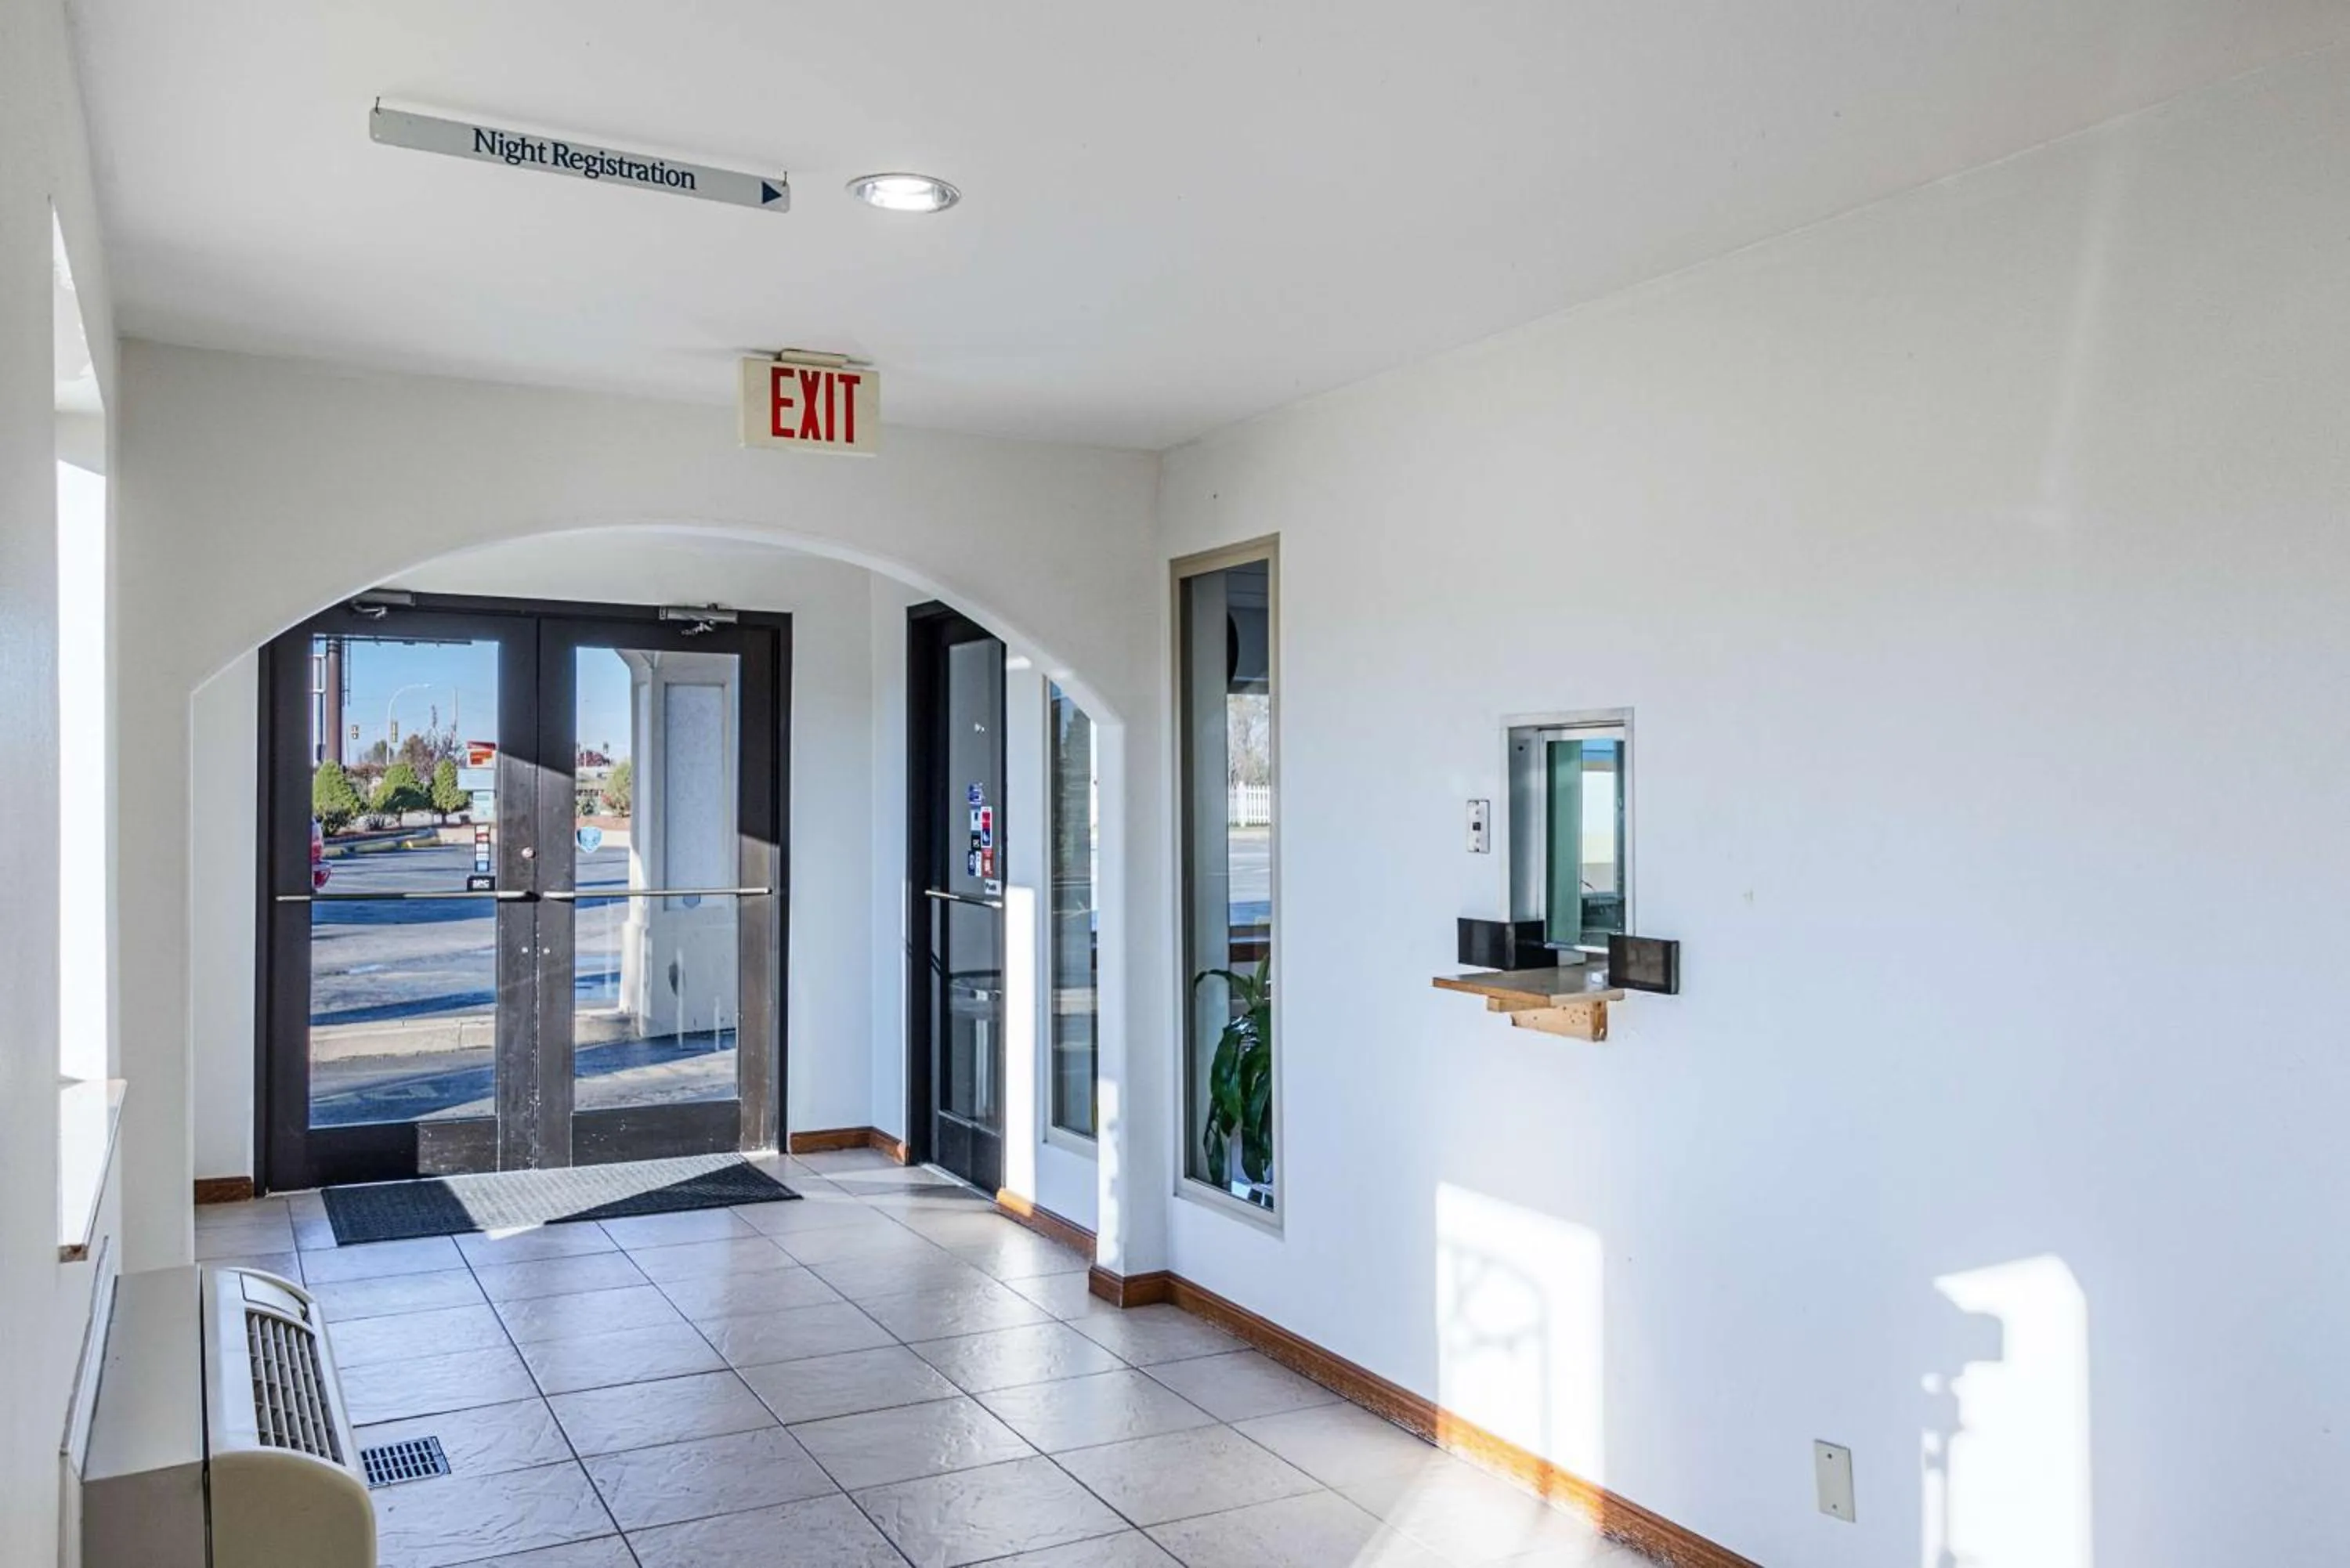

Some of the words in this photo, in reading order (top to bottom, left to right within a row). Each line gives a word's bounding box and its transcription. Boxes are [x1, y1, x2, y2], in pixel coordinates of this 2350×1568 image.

[472, 128, 548, 165] Night
[551, 142, 696, 190] Registration
[771, 367, 861, 443] EXIT
